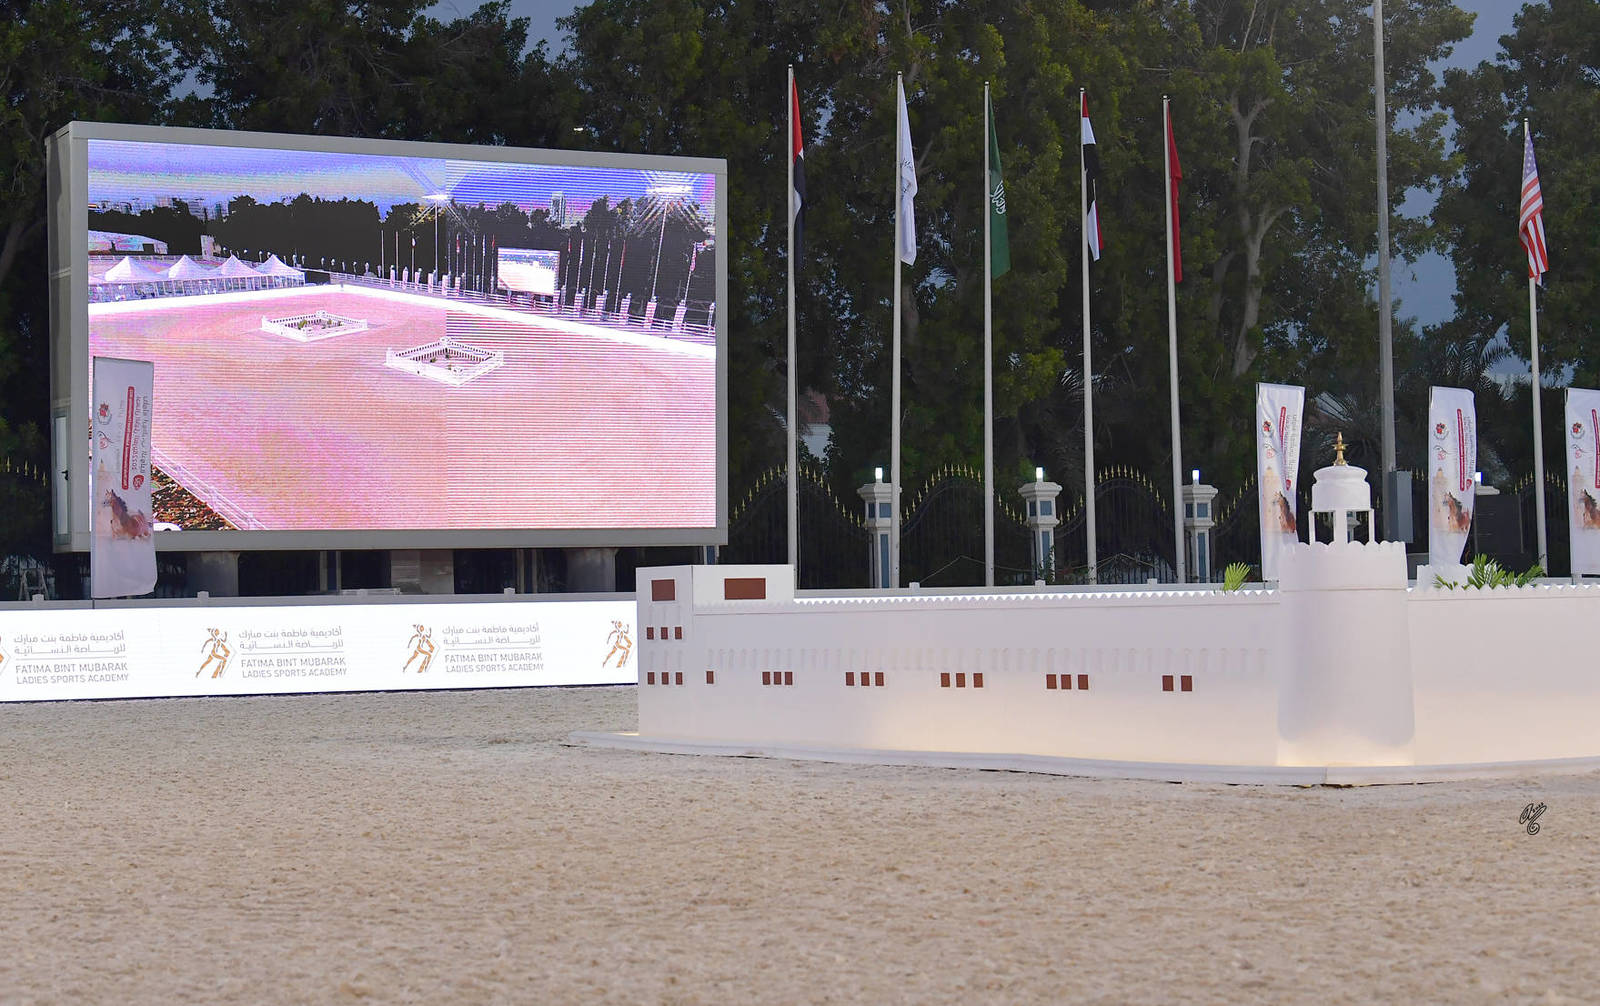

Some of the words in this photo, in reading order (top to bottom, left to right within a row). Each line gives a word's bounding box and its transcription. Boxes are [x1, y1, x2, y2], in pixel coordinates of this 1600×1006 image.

[280, 628, 308, 637] فاطمة
[442, 625, 464, 636] مبارك
[482, 625, 508, 634] فاطمة
[14, 634, 38, 644] مبارك
[59, 633, 88, 642] فاطمة
[238, 630, 262, 640] مبارك
[241, 659, 275, 668] FATIMA
[276, 658, 298, 667] BINT
[300, 657, 346, 666] MUBARAK
[444, 654, 476, 663] FATIMA
[478, 654, 500, 662] BINT
[500, 652, 543, 661] MUBARAK
[16, 664, 51, 674] FATIMA
[54, 664, 76, 672] BINT
[80, 662, 128, 672] MUBARAK
[242, 670, 272, 678] LADIES
[274, 669, 307, 678] SPORTS
[308, 668, 348, 676] ACADEMY
[446, 664, 474, 673] LADIES
[476, 664, 506, 672] SPORTS
[508, 663, 544, 672] ACADEMY
[16, 676, 48, 684] LADIES
[50, 674, 86, 683] SPORTS
[88, 673, 129, 682] ACADEMY
